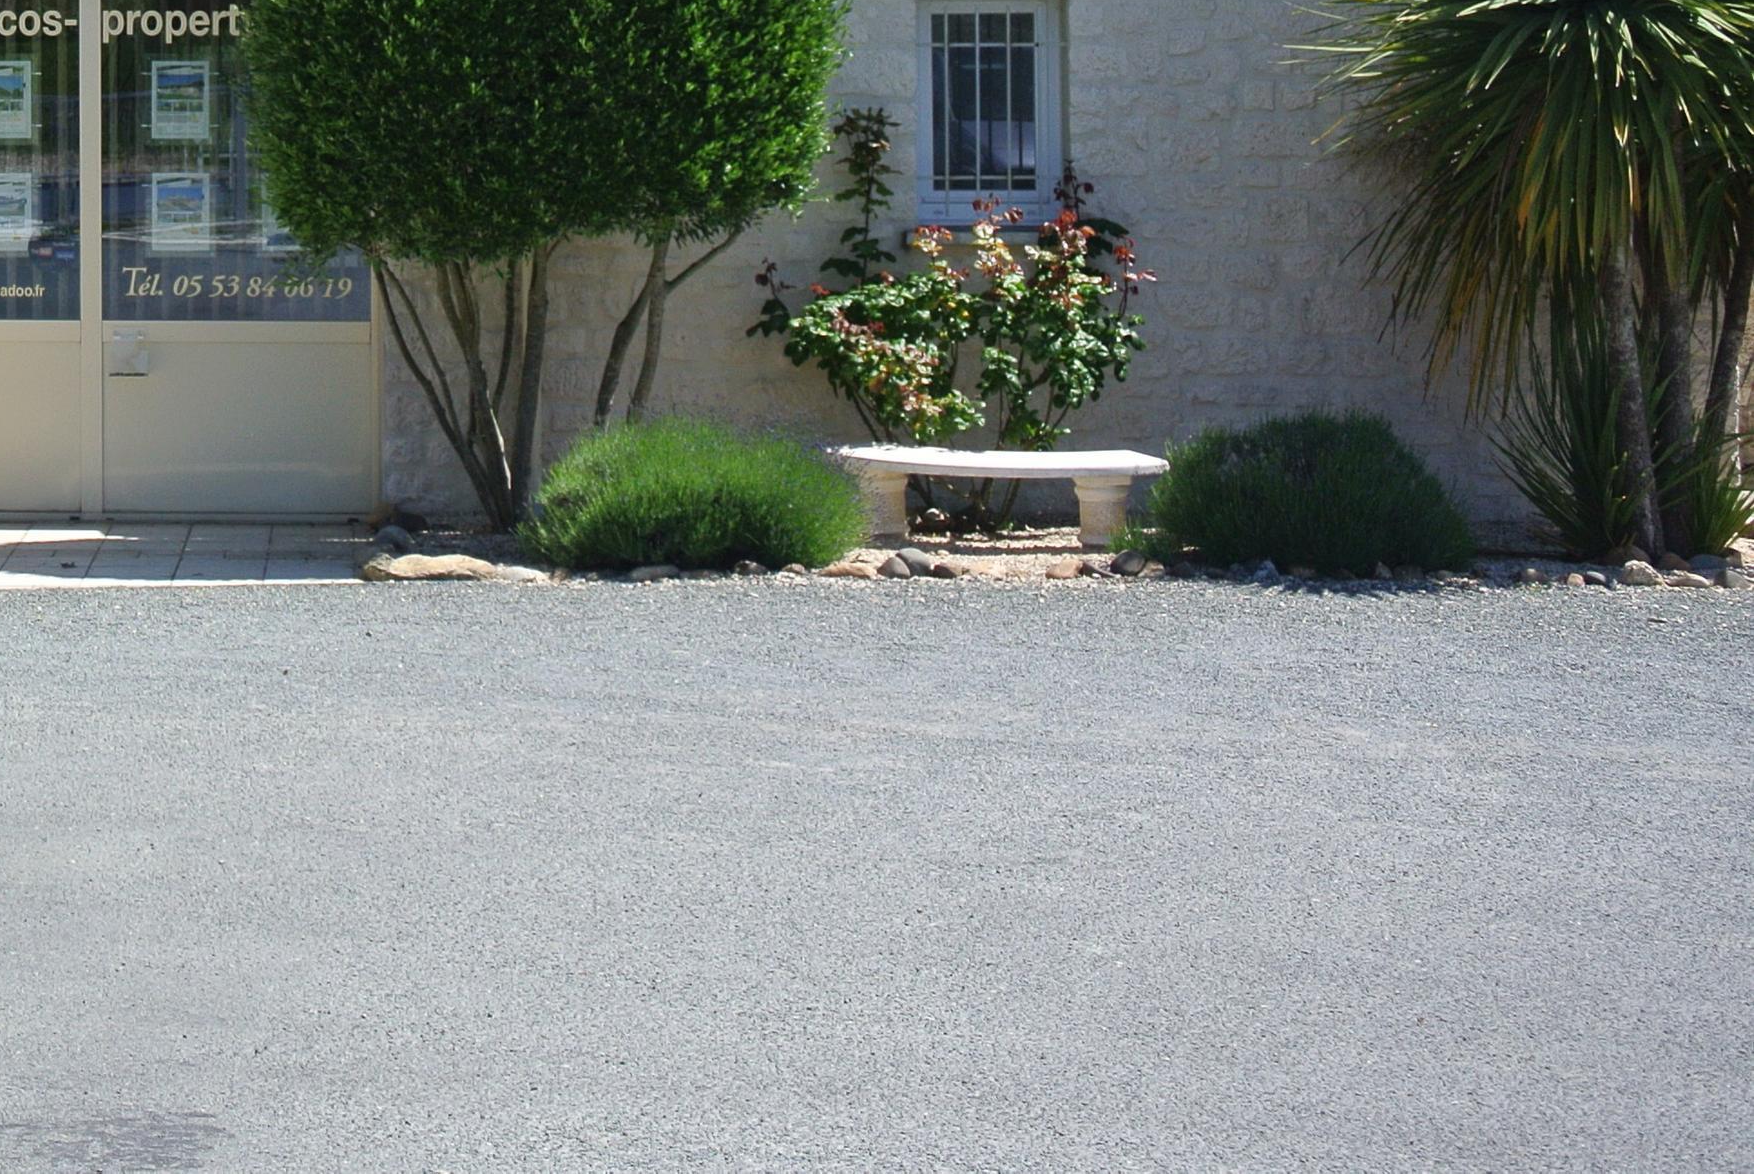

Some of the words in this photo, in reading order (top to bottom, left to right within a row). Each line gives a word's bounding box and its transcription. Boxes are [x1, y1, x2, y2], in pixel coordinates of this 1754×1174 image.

[122, 266, 163, 297] Tél.
[173, 275, 202, 298] 05
[209, 275, 240, 298] 53
[247, 275, 278, 298] 84
[324, 275, 352, 300] 19
